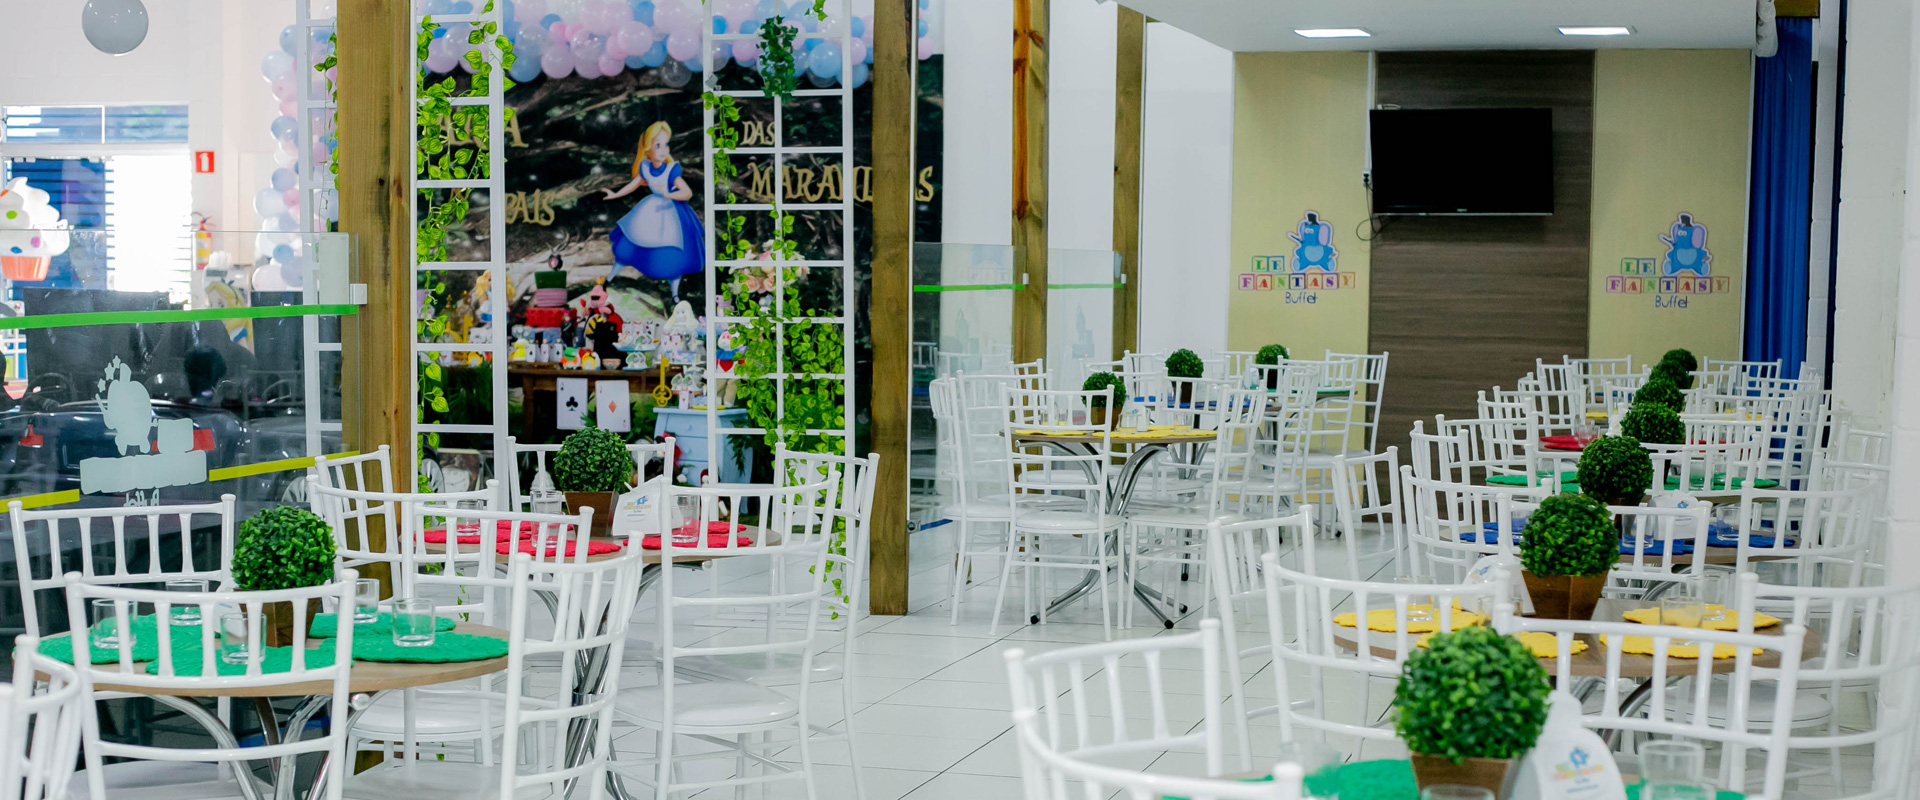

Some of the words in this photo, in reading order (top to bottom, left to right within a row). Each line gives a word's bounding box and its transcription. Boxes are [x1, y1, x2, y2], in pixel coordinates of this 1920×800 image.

[740, 120, 775, 146] DAS
[747, 162, 934, 203] MARAVILS
[1253, 258, 1283, 271] LE
[1623, 260, 1654, 274] LE
[1240, 275, 1353, 290] FANTASY
[1608, 278, 1727, 292] FANTASY
[1285, 291, 1318, 304] Buffet
[1655, 295, 1689, 308] Buffet
